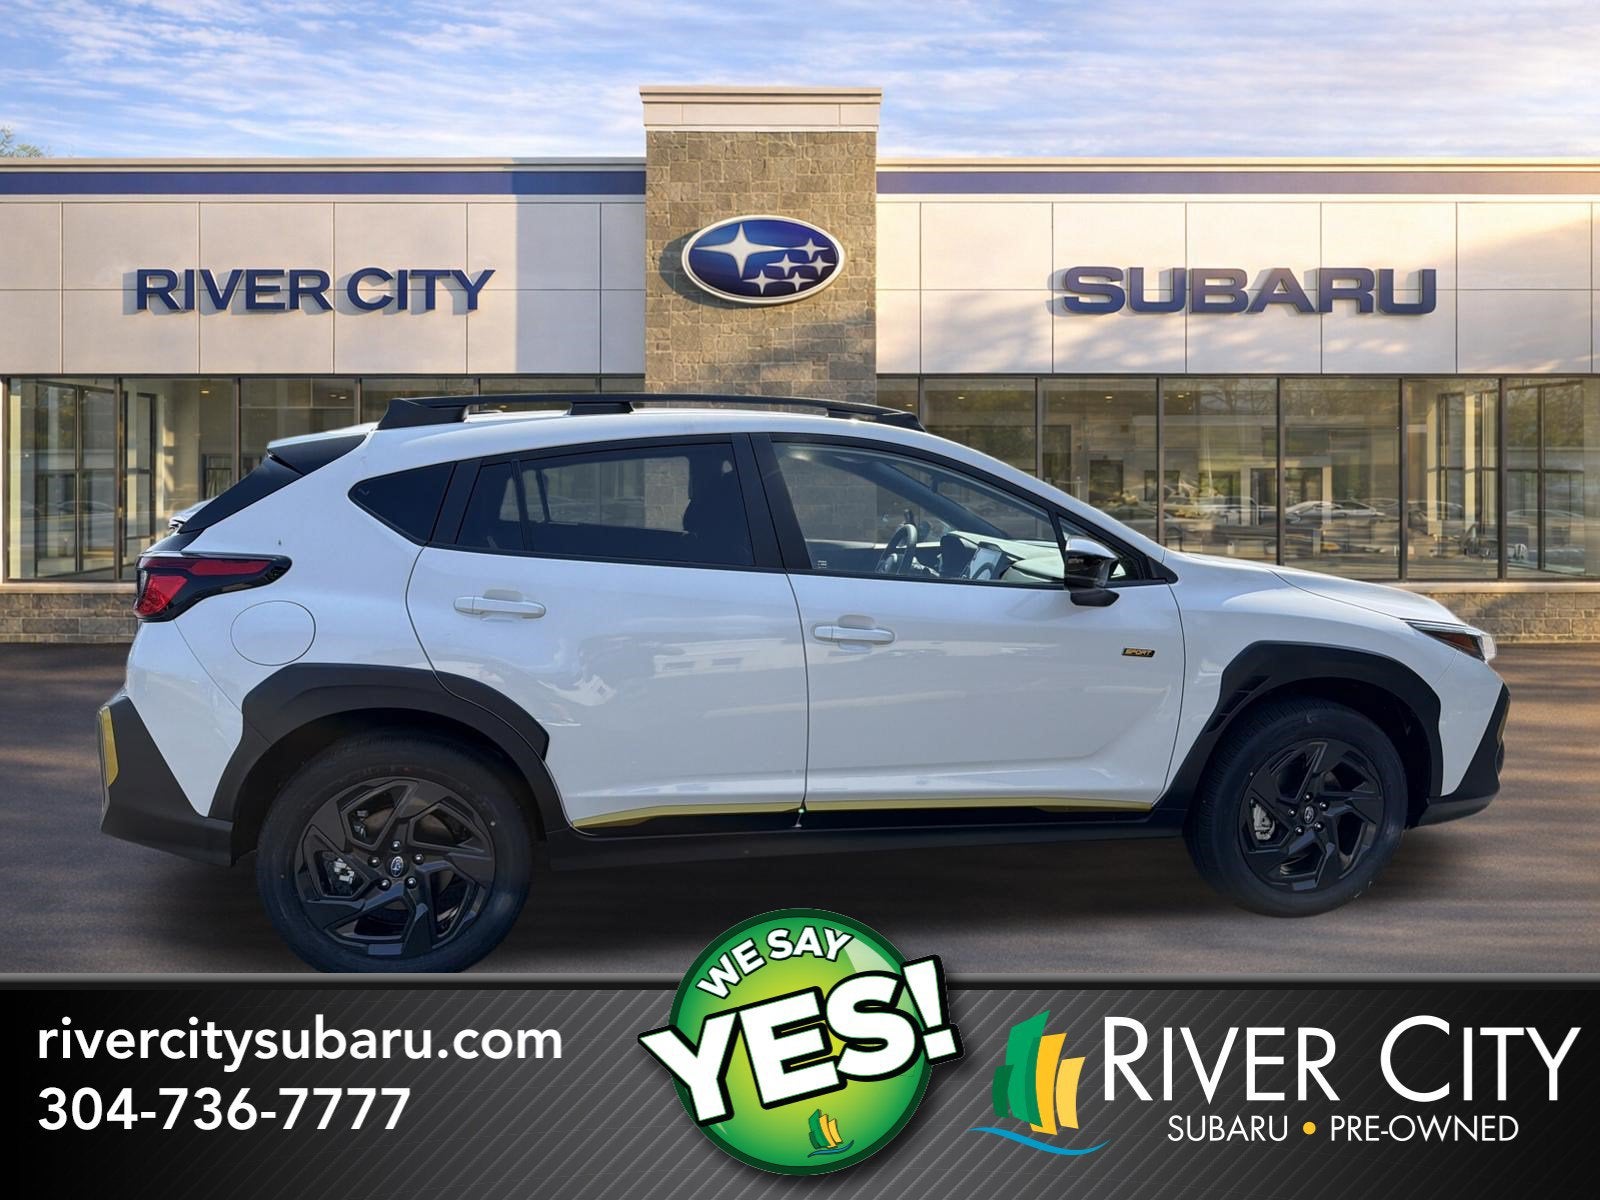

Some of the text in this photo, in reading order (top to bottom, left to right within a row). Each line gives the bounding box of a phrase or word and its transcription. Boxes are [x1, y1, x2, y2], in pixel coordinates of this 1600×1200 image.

[136, 267, 495, 311] RIVER CITY
[1063, 266, 1437, 315] SUBARU
